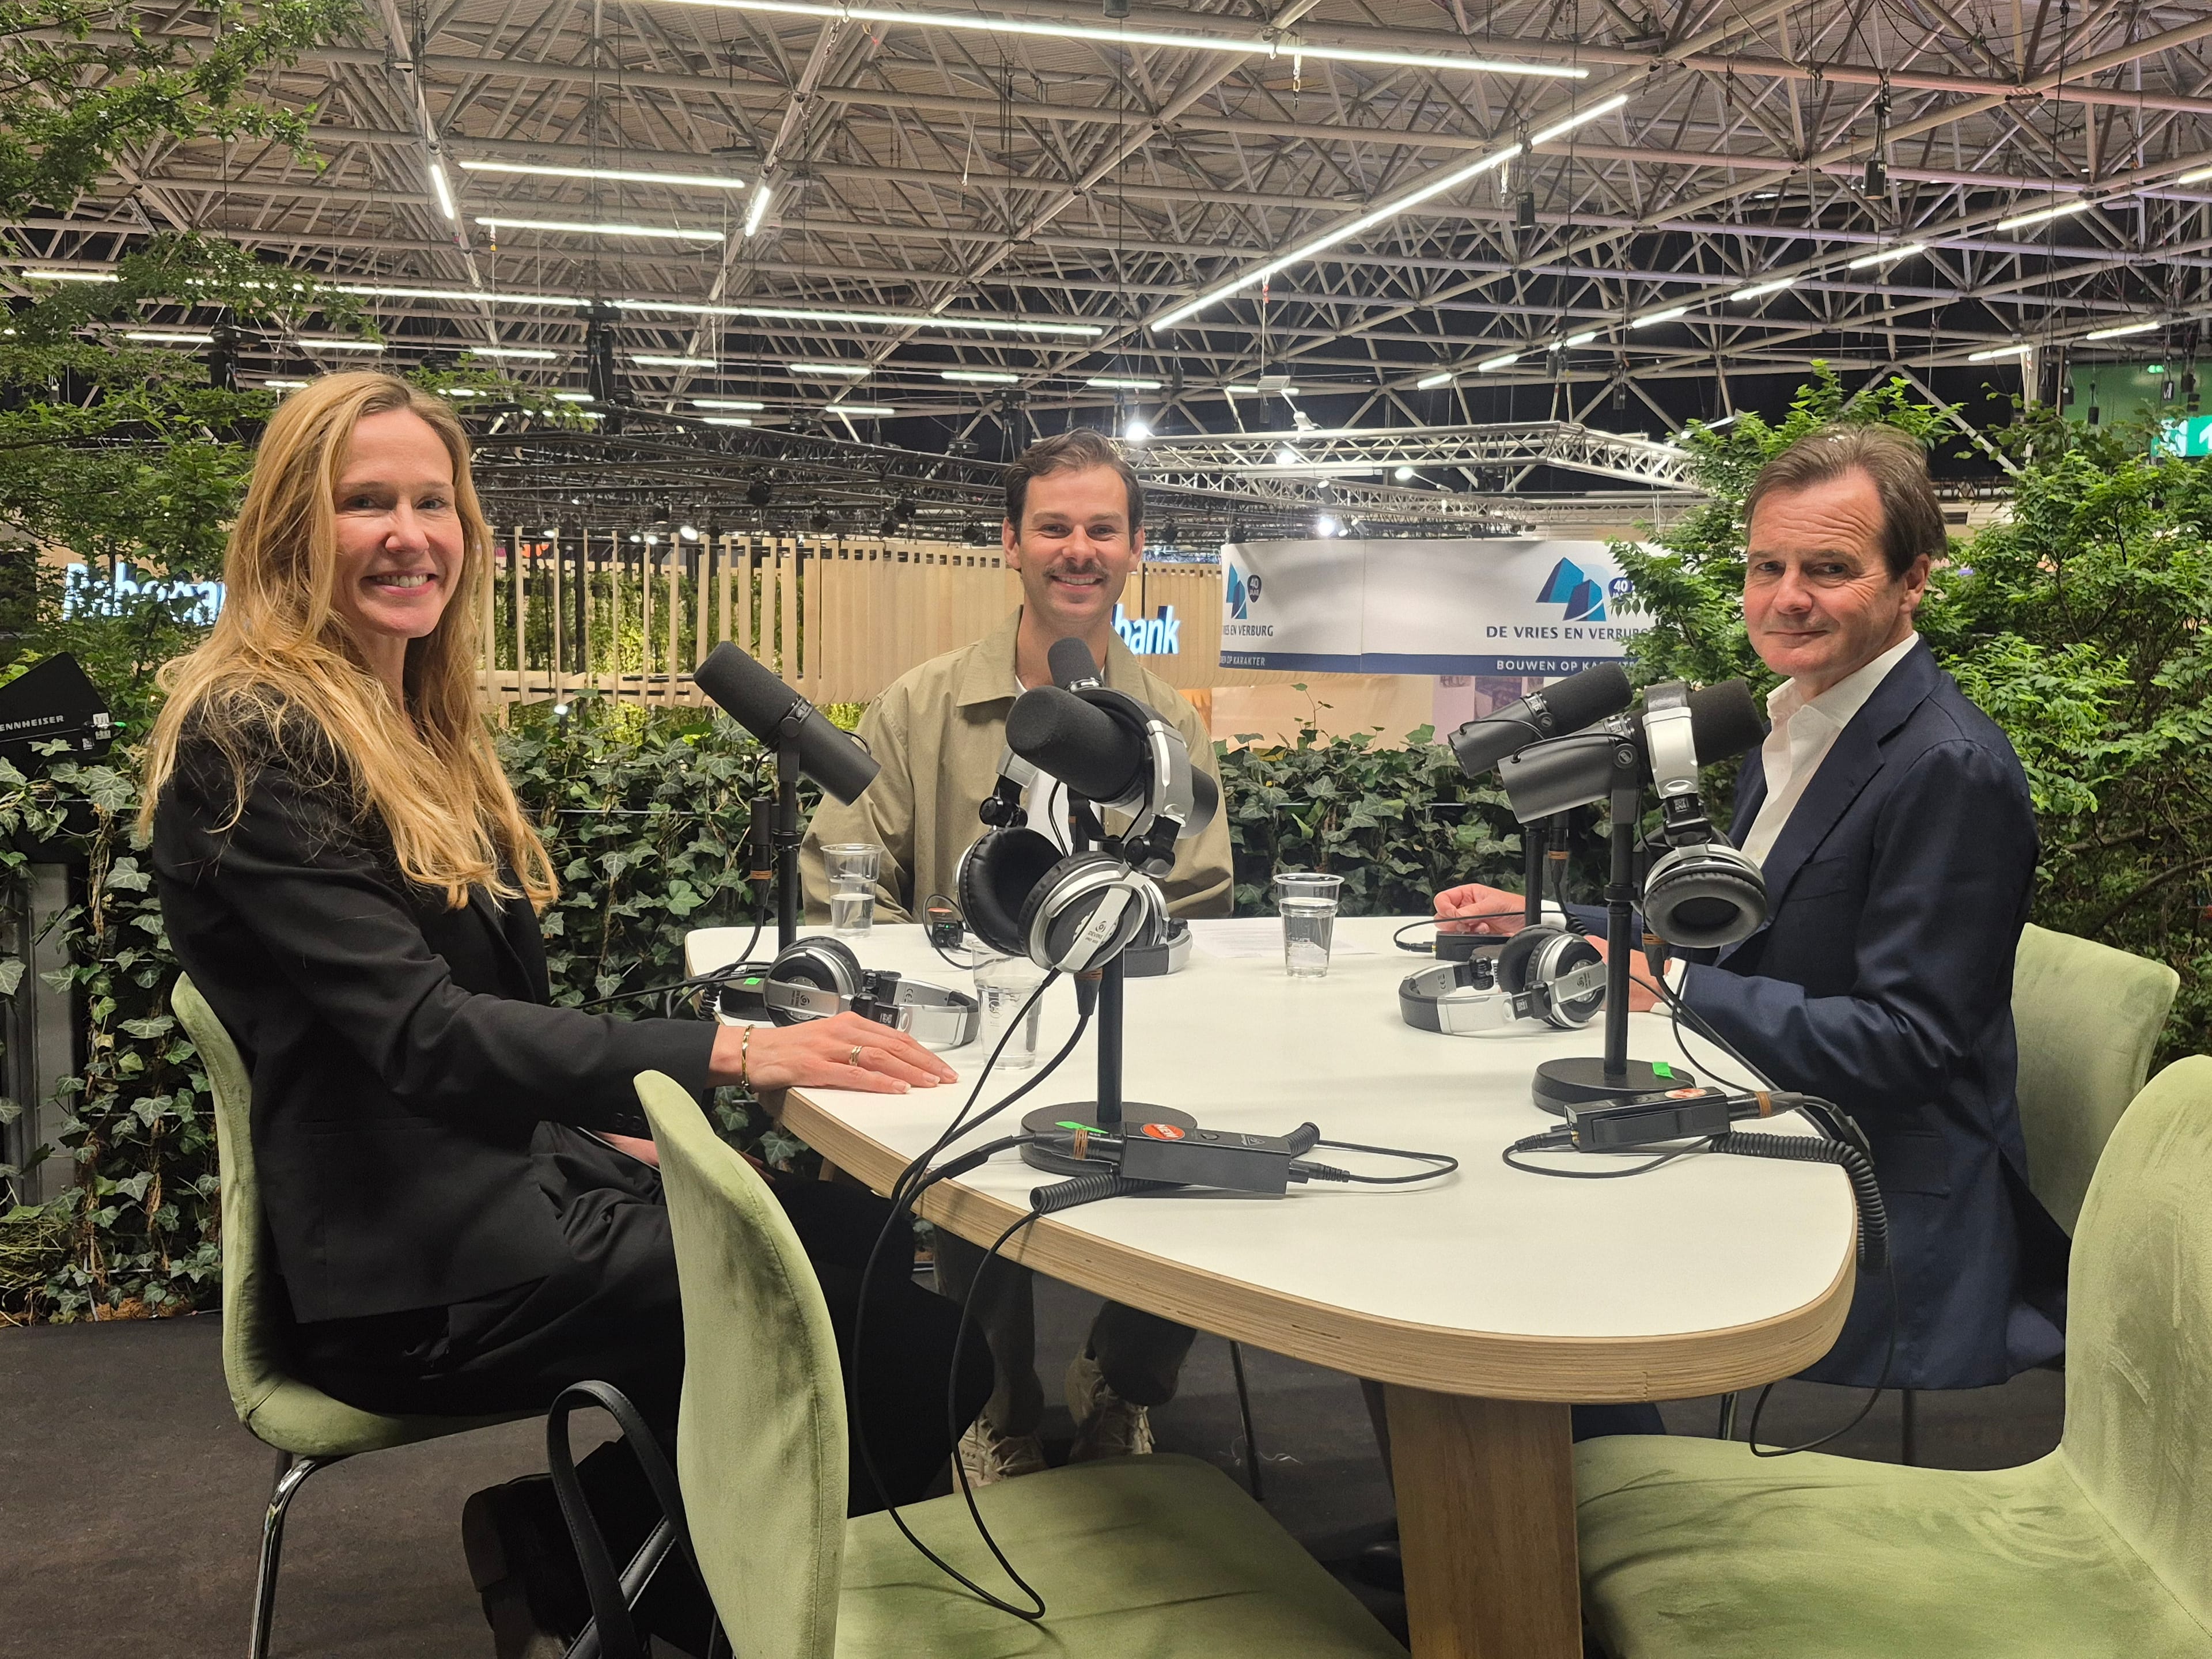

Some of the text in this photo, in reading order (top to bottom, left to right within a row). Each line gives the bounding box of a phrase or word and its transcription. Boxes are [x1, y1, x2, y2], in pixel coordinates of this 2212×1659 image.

[1250, 578, 1259, 589] 40
[1613, 580, 1628, 593] 40
[1112, 603, 1180, 654] bank
[1238, 625, 1273, 637] VERBURG
[1486, 626, 1508, 638] DE
[1514, 626, 1558, 639] VRIES
[1565, 628, 1583, 639] EN
[1233, 656, 1265, 666] KARAKTER
[1497, 661, 1555, 672] BOUWEN
[1560, 661, 1577, 672] OP
